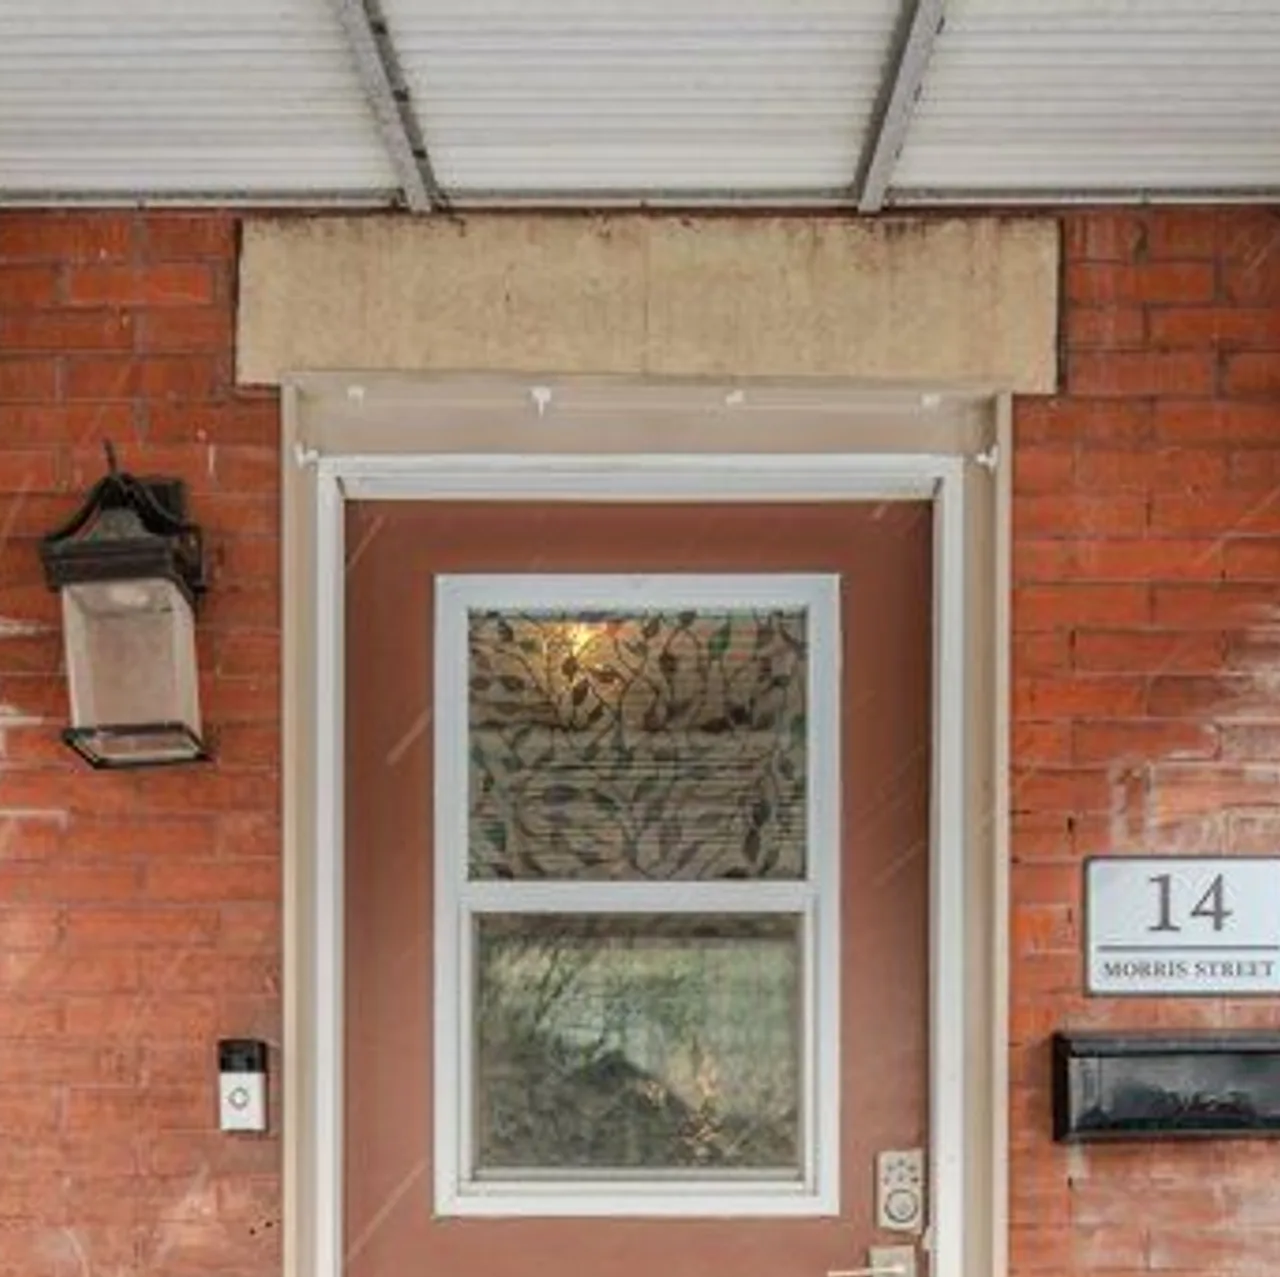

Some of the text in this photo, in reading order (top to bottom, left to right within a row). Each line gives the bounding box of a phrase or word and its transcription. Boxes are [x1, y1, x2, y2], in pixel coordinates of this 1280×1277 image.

[1146, 872, 1234, 933] 14
[1103, 960, 1276, 978] MORRIS STREET
